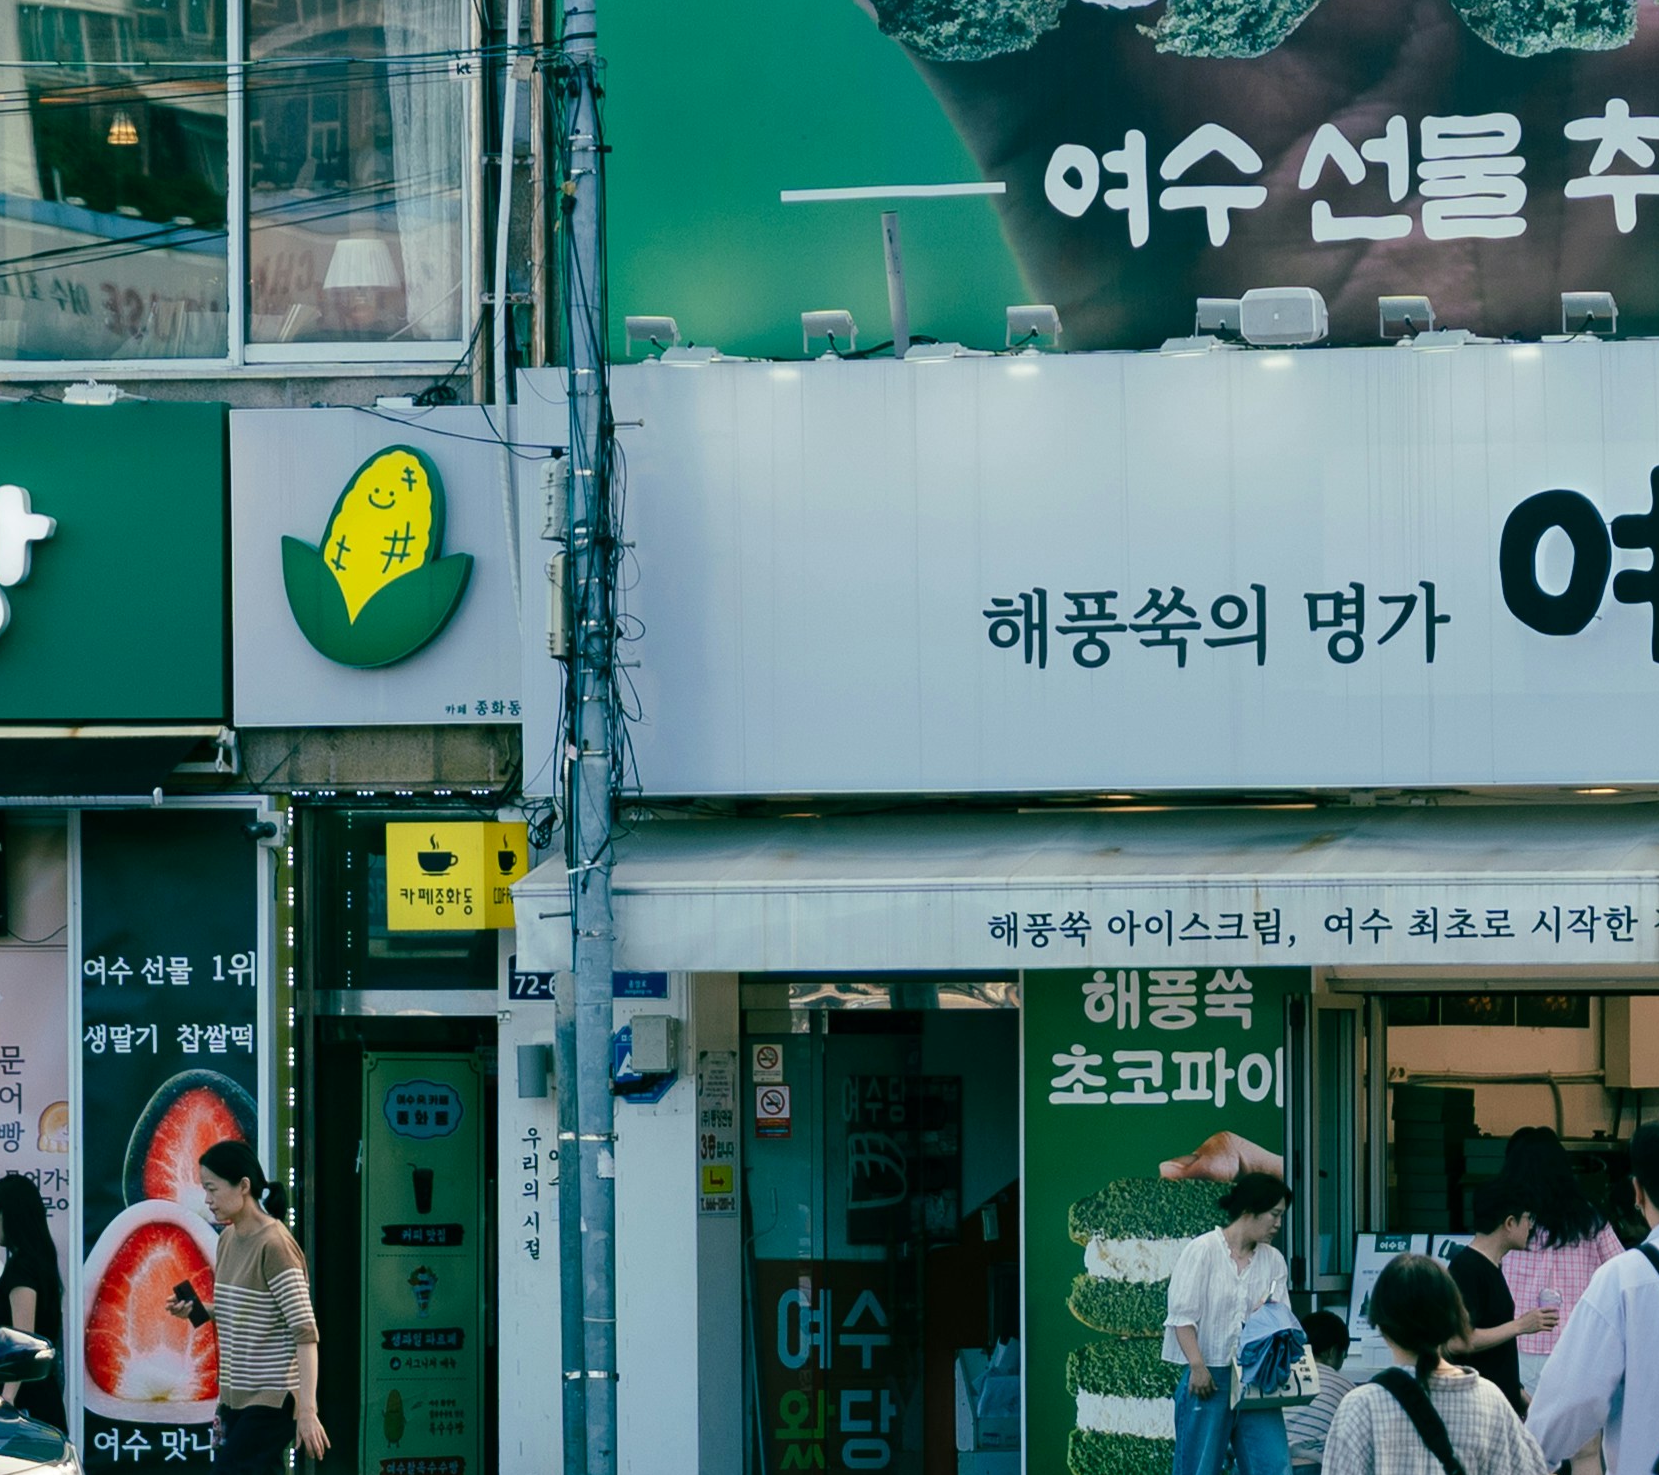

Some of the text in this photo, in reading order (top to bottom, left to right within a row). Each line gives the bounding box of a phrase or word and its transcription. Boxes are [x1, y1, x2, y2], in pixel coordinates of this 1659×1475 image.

[1043, 121, 1269, 248] 여수
[1298, 111, 1528, 243] 선물
[983, 579, 1451, 673] 해풍쑥의 명가
[445, 700, 522, 716] 카페 종화동
[400, 887, 473, 915] 카페종화동
[988, 912, 1092, 948] 해풍쑥
[1108, 909, 1299, 948] 아이스크림,
[1323, 908, 1394, 945] 여수
[1408, 906, 1517, 943] 최초로
[1531, 904, 1639, 944] 시작한
[84, 952, 257, 986] 여수 선물 1위
[1081, 970, 1254, 1030] 해풍쑥
[84, 1023, 254, 1055] 생딸기 찹쌀떡
[1049, 1044, 1284, 1107] 초코파이
[94, 1429, 152, 1463] 여수
